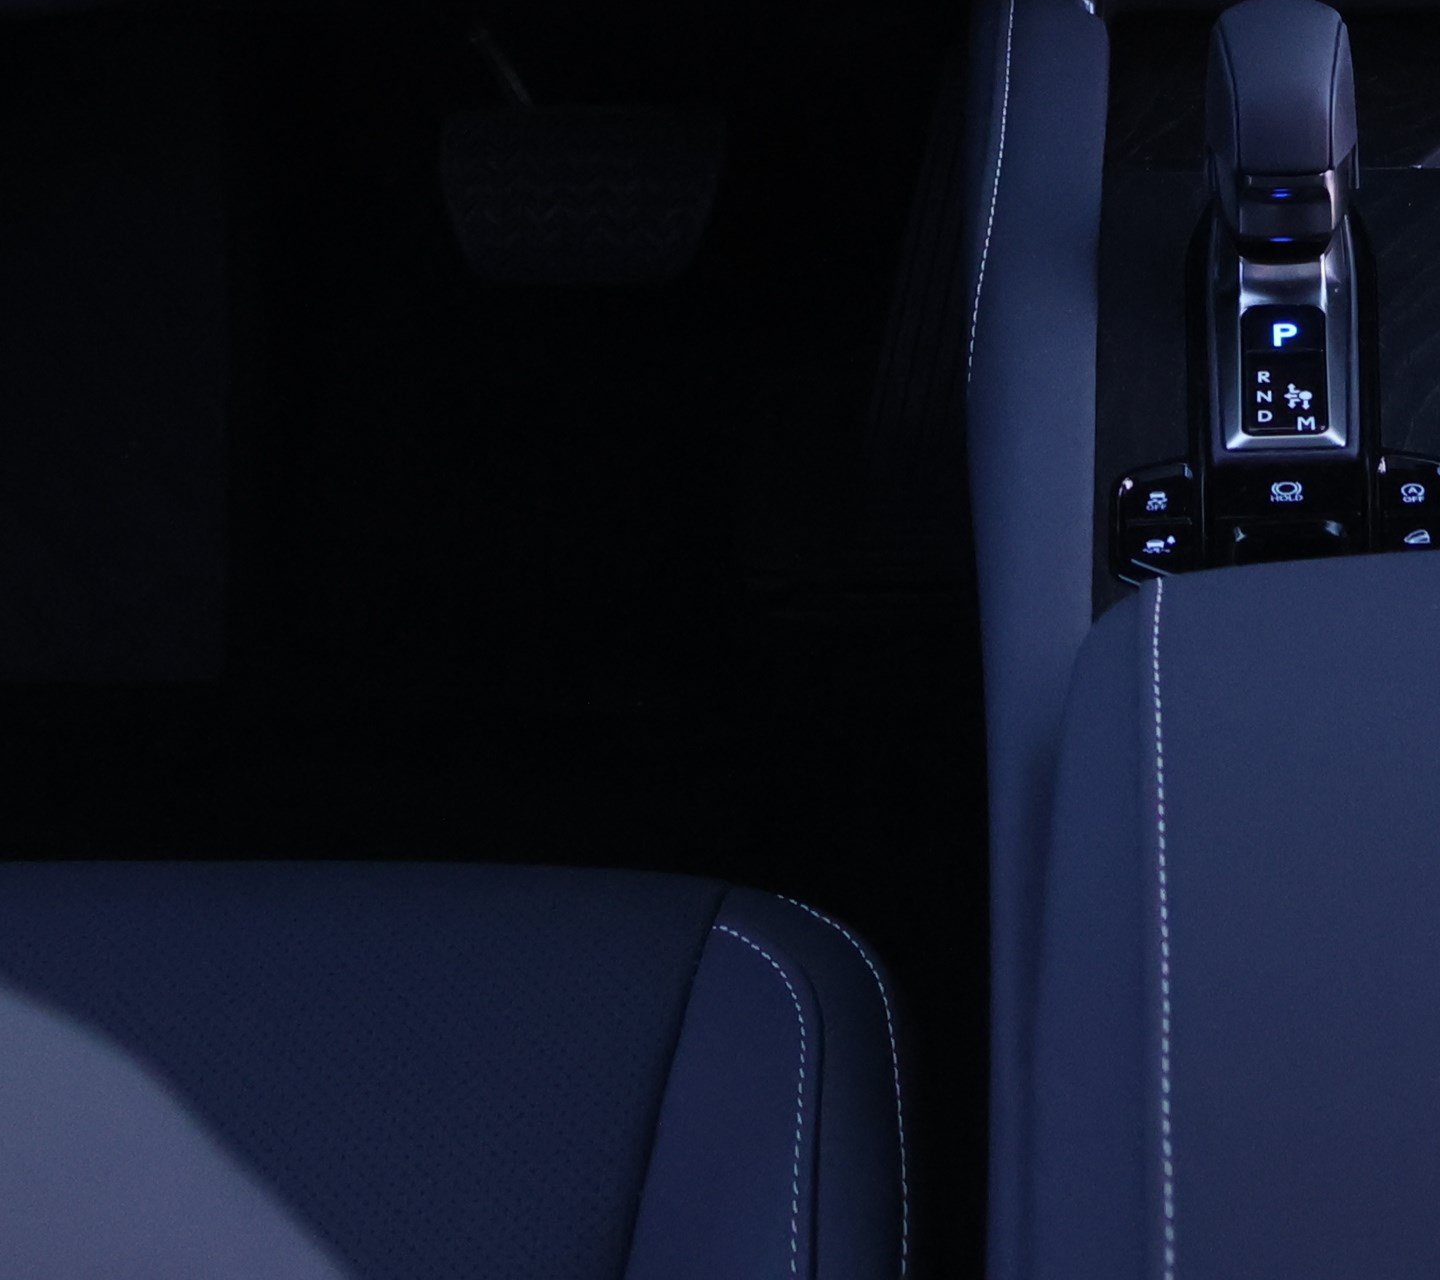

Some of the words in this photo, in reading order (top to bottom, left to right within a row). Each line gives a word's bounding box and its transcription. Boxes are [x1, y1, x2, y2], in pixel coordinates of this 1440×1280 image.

[1273, 323, 1298, 347] P
[1257, 371, 1271, 383] R
[1257, 390, 1272, 403] N
[1257, 410, 1273, 423] D
[1297, 416, 1316, 431] M
[1270, 494, 1303, 503] HOLD
[1402, 495, 1425, 503] OFF
